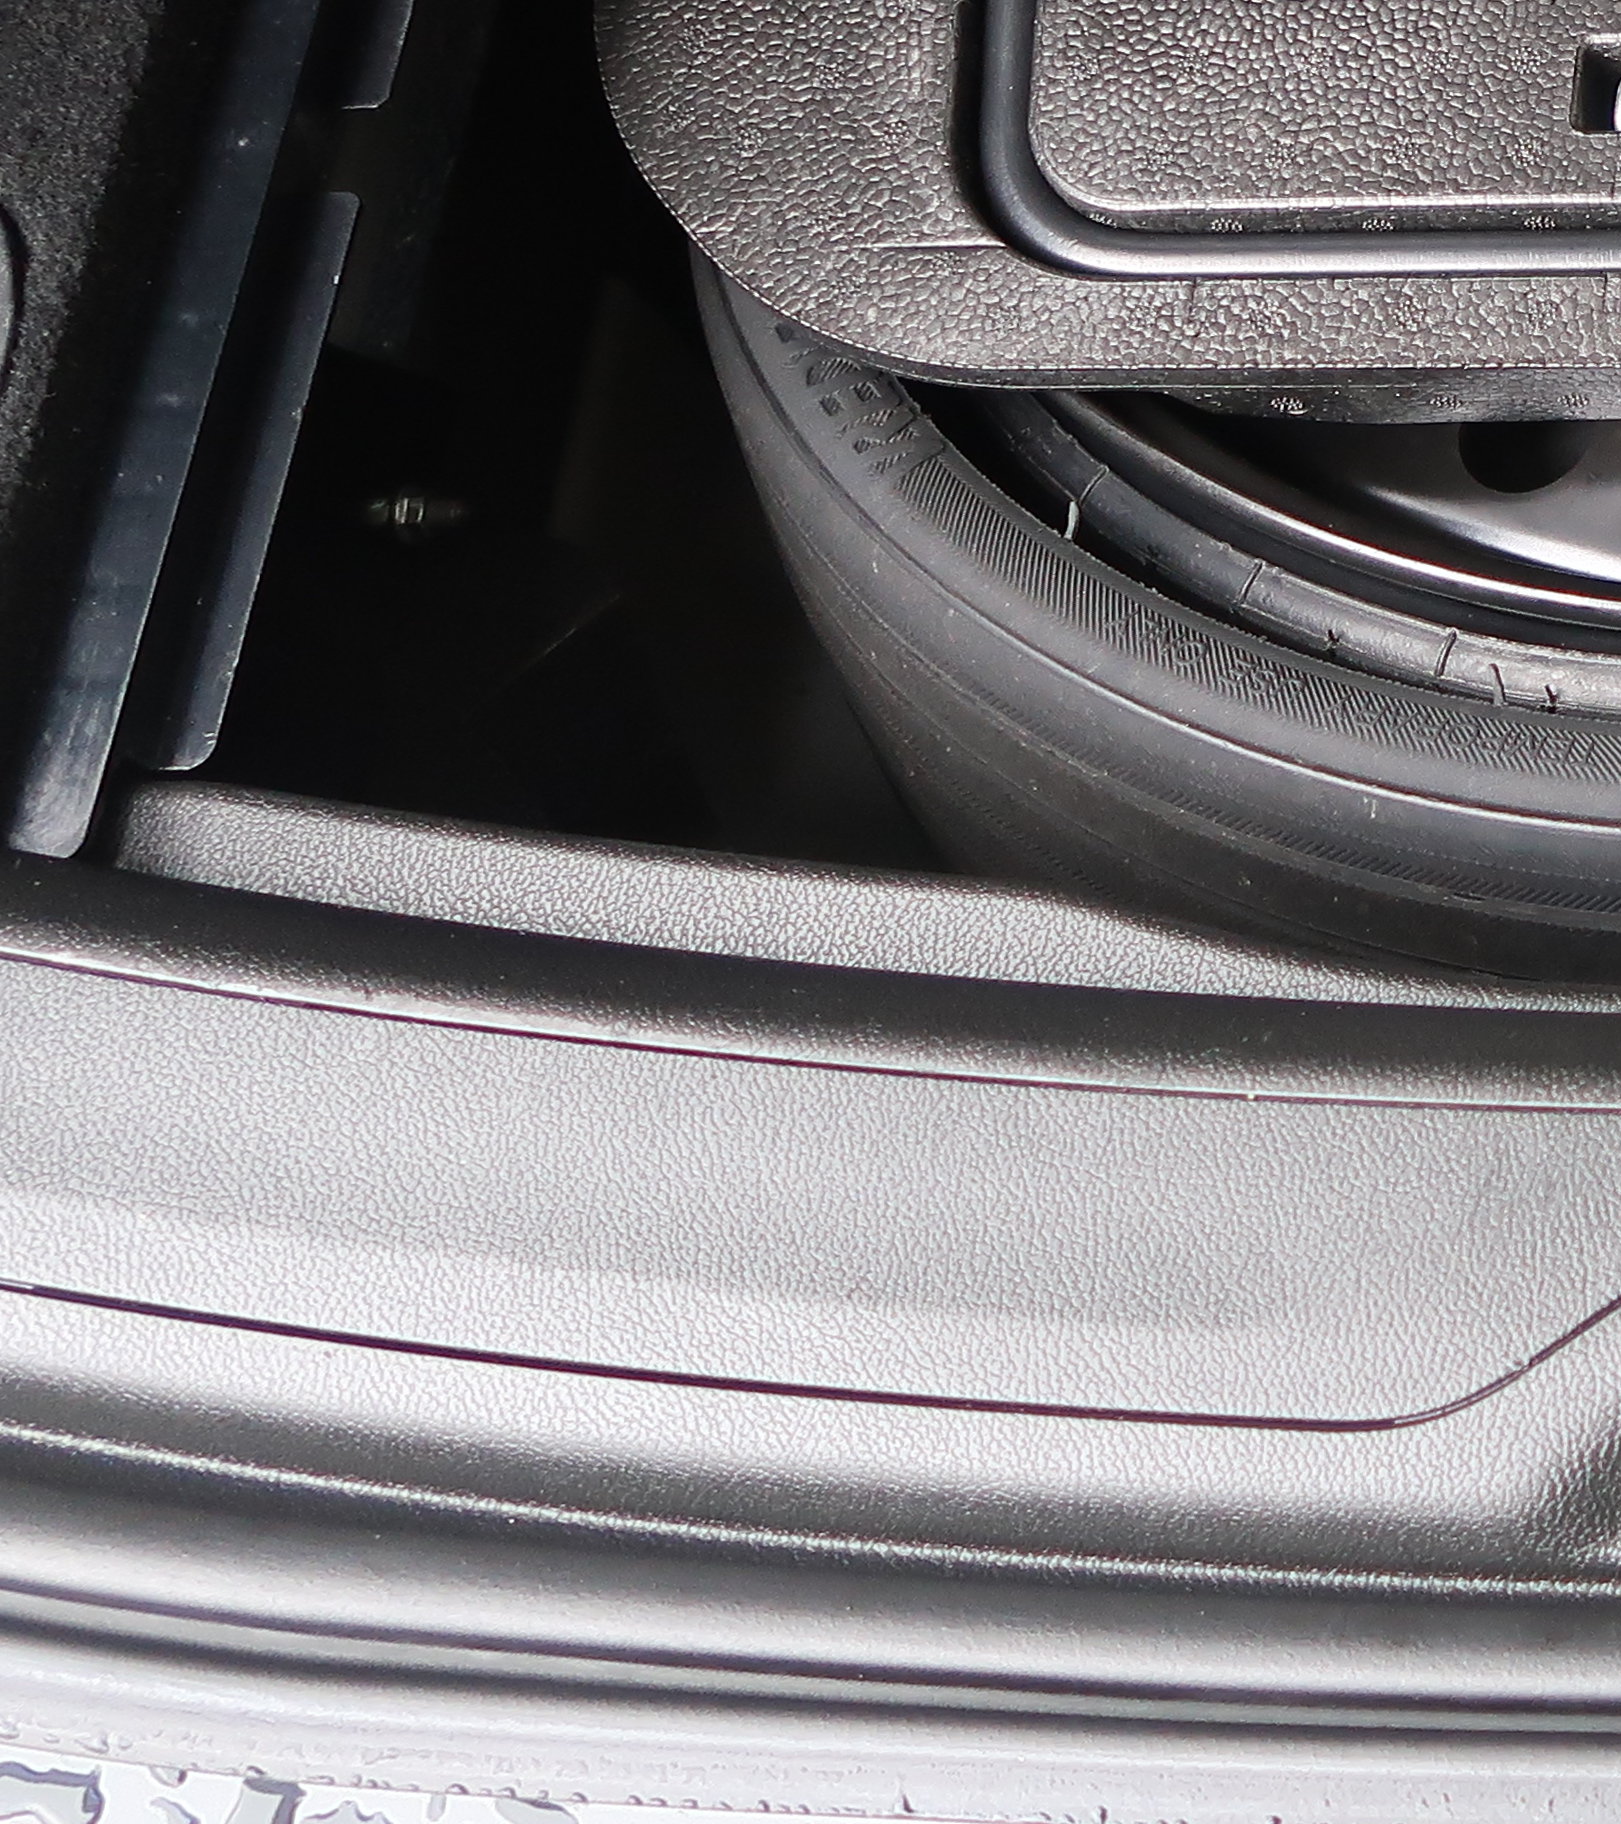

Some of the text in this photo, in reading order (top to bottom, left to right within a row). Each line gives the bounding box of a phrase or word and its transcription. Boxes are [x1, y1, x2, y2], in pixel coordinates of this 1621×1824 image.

[1103, 610, 1205, 667] ONLY
[1217, 658, 1303, 700] USE
[1318, 694, 1594, 768] TEMPORARY
